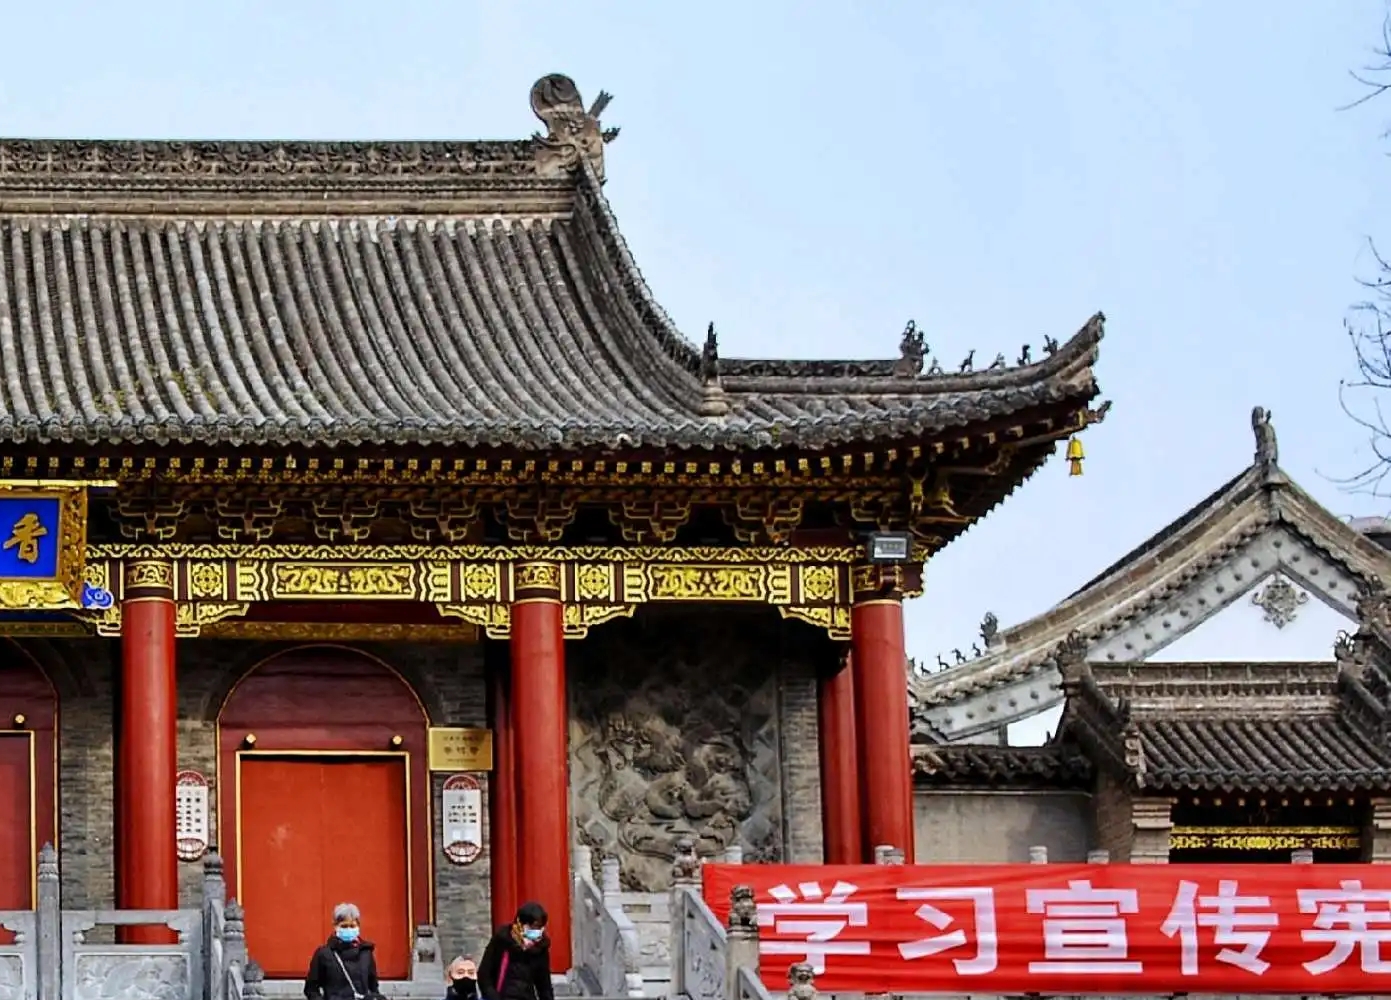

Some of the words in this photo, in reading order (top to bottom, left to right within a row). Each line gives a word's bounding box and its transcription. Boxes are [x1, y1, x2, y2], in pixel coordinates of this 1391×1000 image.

[758, 879, 1391, 976] 学习宣传宪
